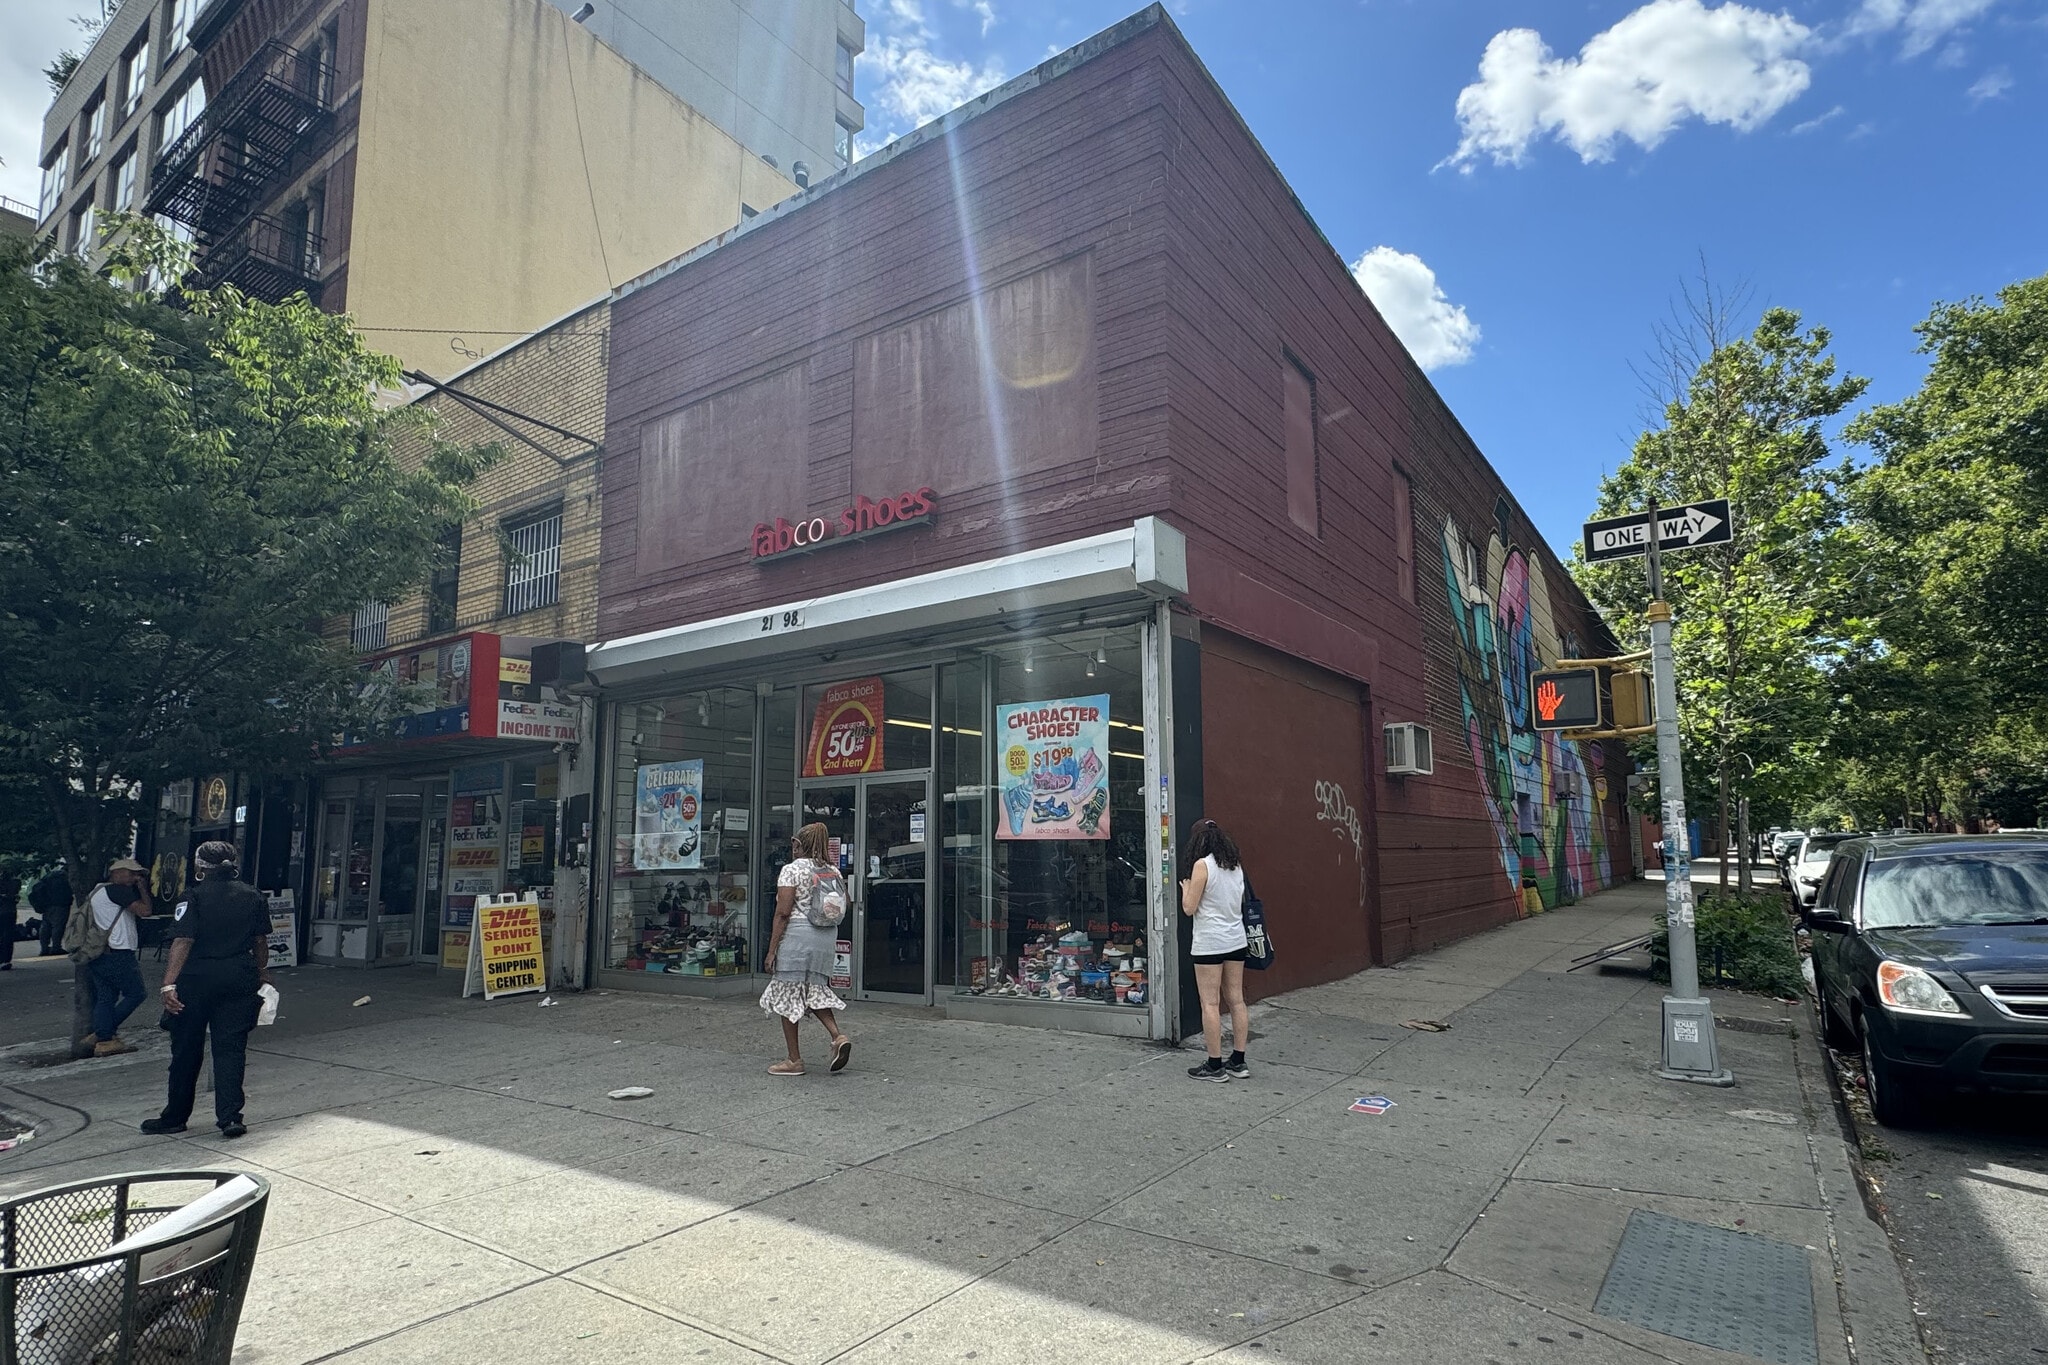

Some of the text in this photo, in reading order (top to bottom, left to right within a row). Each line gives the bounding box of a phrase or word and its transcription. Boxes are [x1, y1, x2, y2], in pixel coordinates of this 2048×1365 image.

[752, 487, 936, 557] fabco shoes
[1604, 516, 1706, 547] ONE WAY
[784, 610, 799, 628] 98
[826, 684, 875, 704] fabco shoes
[503, 702, 537, 716] FedEx
[543, 706, 574, 719] FedEx
[1007, 706, 1100, 729] CHARACTER
[501, 721, 576, 740] INCOME TAX
[1026, 722, 1080, 741] SHOES!
[823, 757, 863, 770] 2nd item
[645, 769, 697, 790] CELEBRATE
[453, 826, 499, 841] FedEx FedEx
[1053, 827, 1070, 835] shoes
[456, 850, 499, 866] DHL
[489, 907, 532, 929] DHL
[484, 927, 539, 942] SERVICE
[493, 942, 532, 956] POINT
[488, 958, 537, 975] SHIPPING
[496, 973, 535, 989] CENTER
